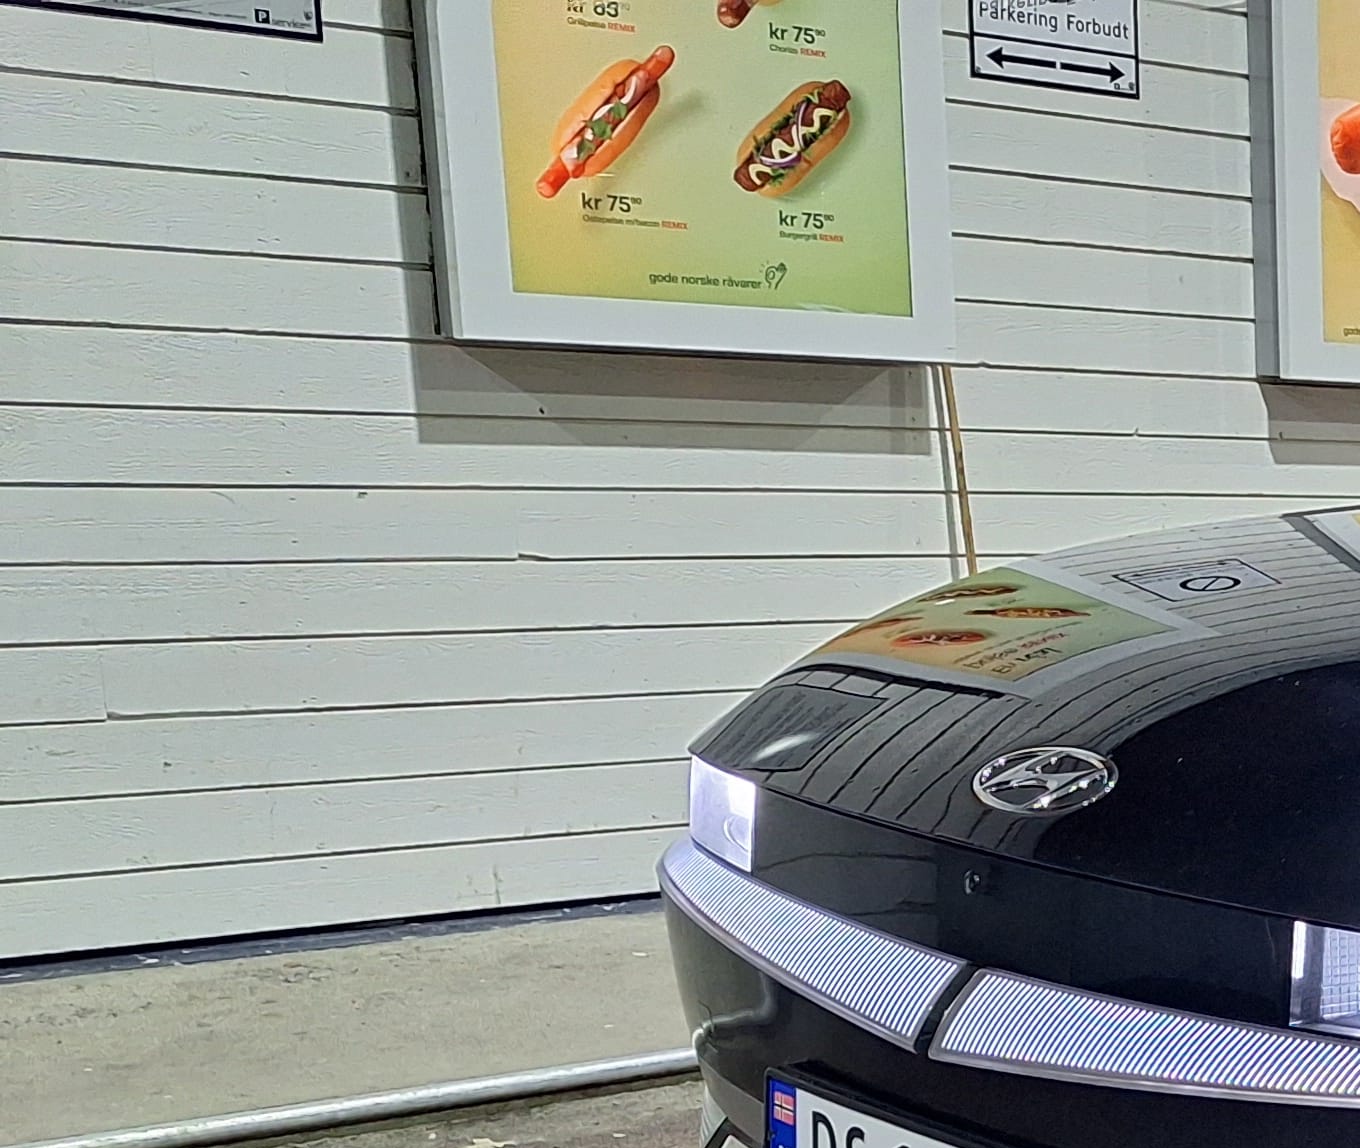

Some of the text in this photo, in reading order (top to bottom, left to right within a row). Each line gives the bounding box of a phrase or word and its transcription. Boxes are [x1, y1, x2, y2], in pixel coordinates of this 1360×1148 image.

[979, 2, 1129, 40] Parkering Forbudt
[769, 22, 788, 40] kr
[581, 192, 602, 211] kr
[779, 209, 798, 227] kr
[649, 272, 678, 285] gode
[681, 275, 720, 287] norske
